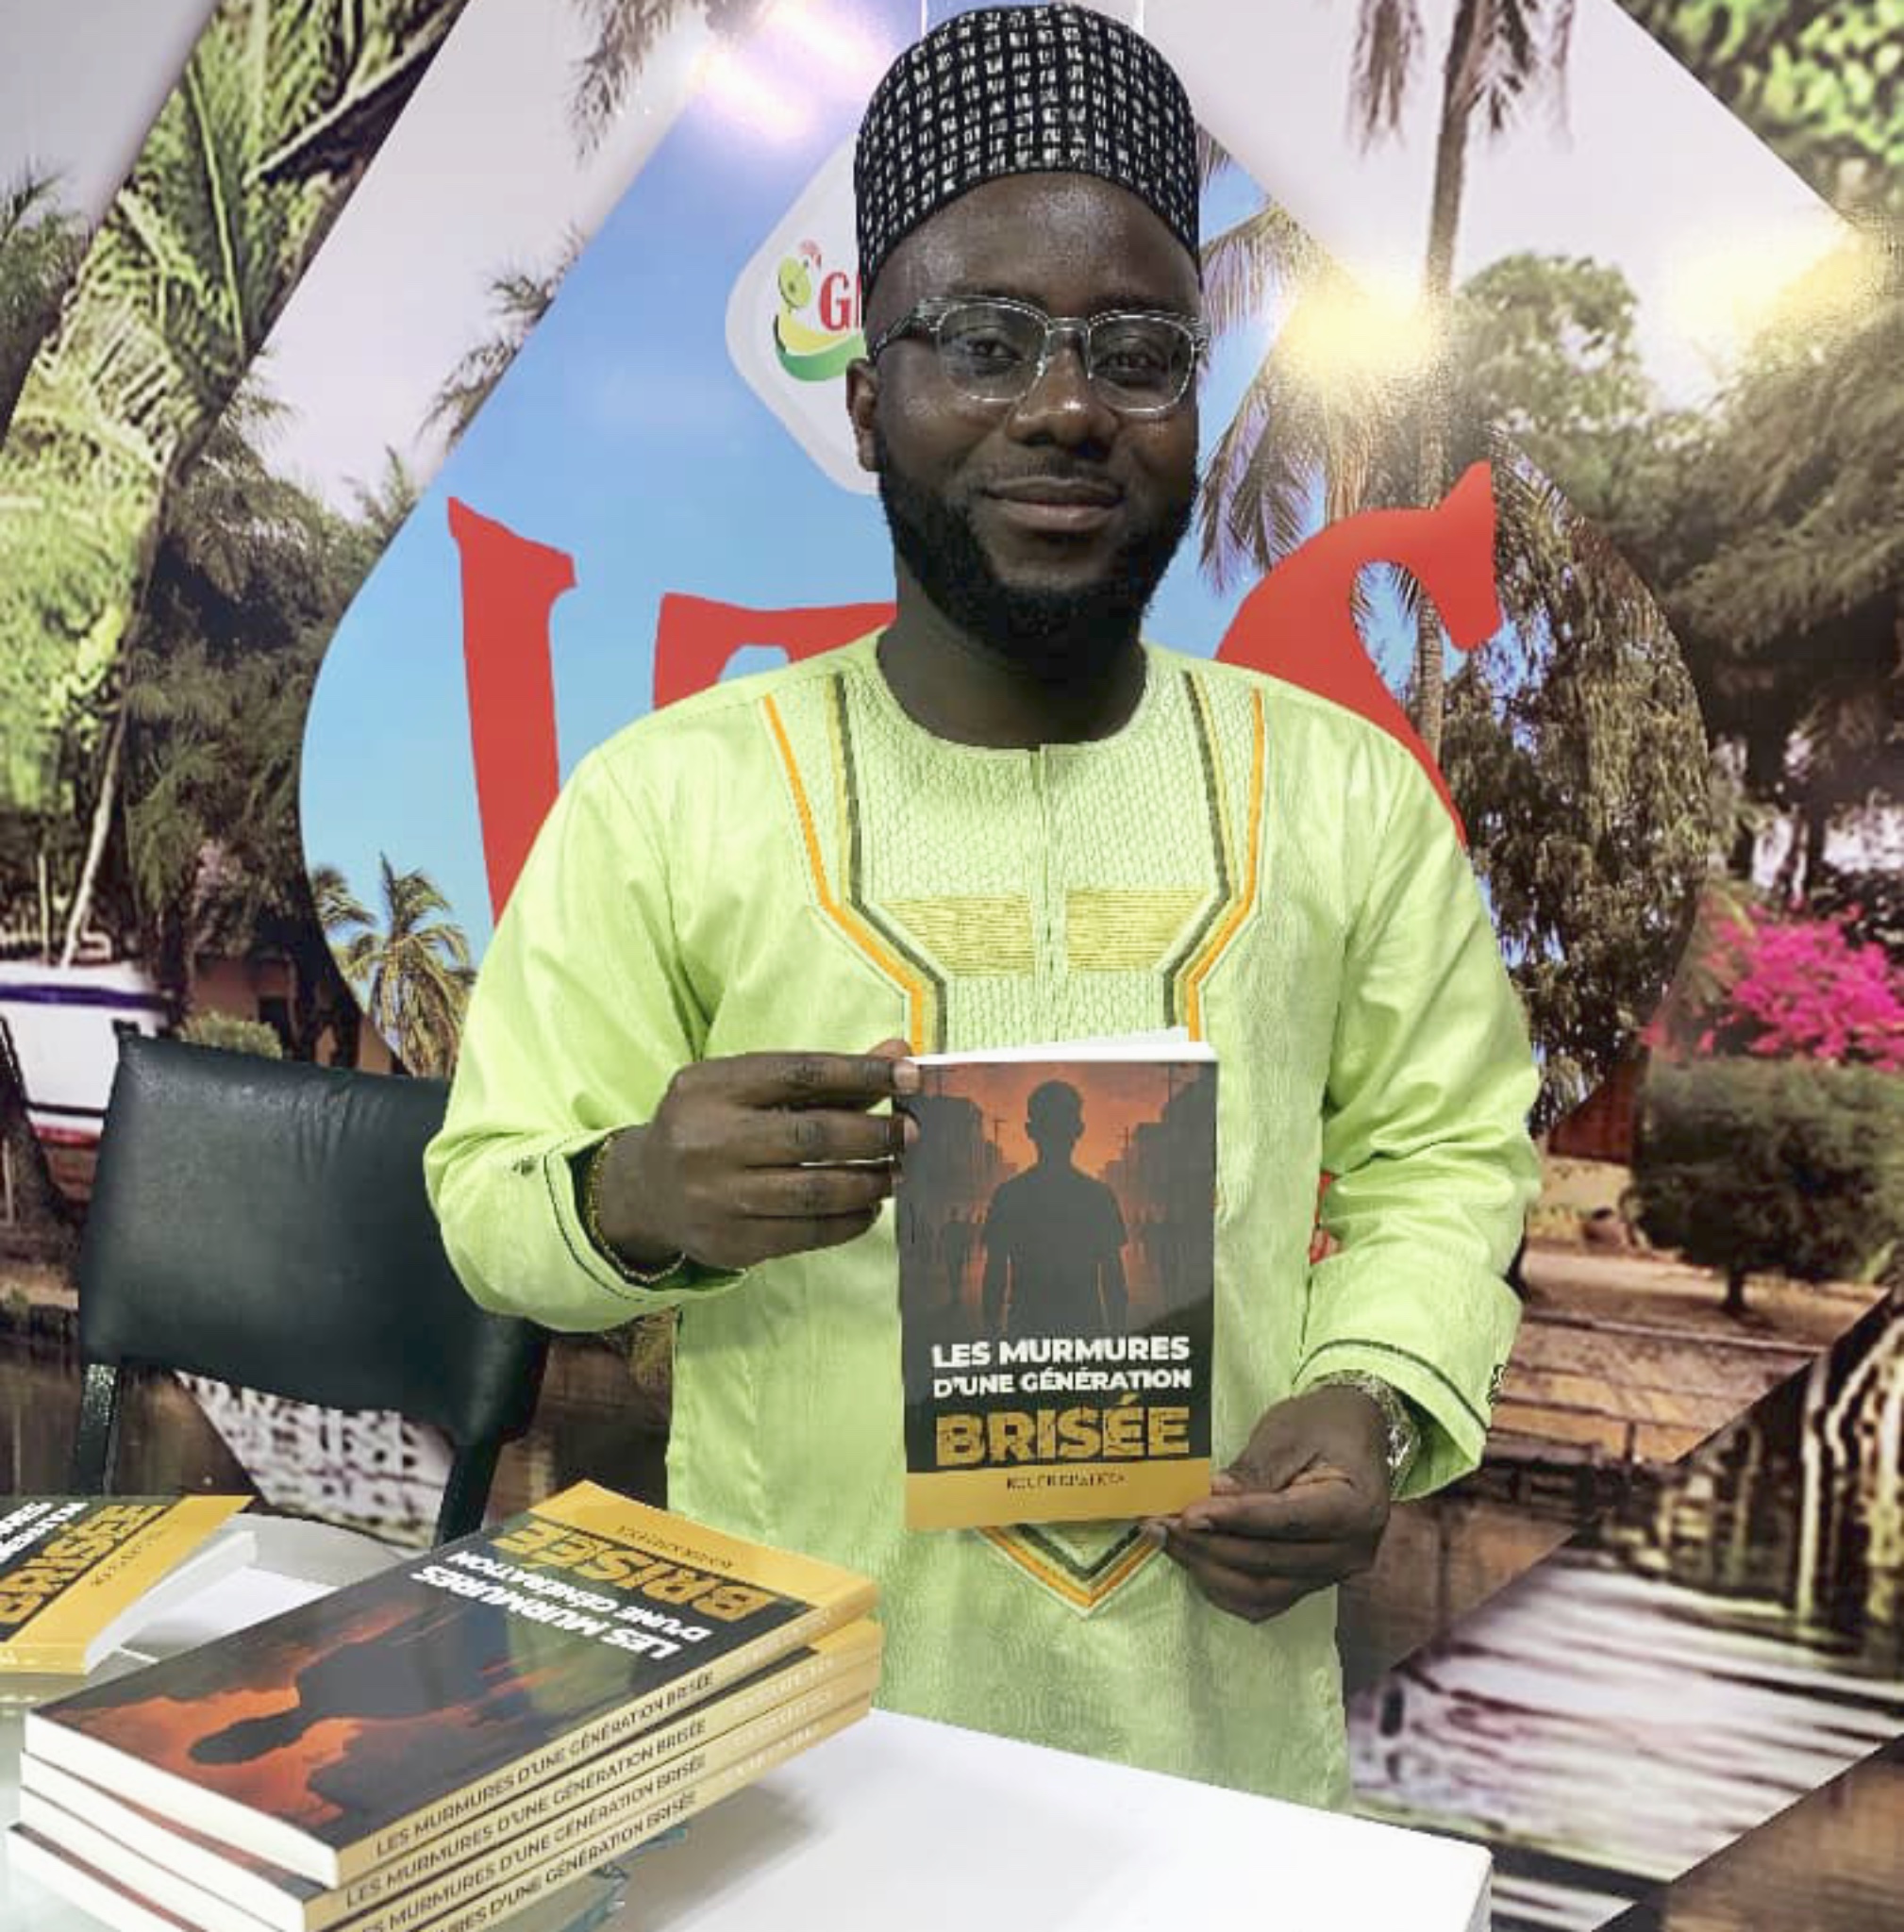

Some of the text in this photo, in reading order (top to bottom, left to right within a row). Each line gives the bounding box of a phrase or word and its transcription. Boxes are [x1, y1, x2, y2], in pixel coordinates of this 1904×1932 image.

[932, 1336, 1190, 1368] LES MURMURES
[932, 1368, 1192, 1398] D'UNE GÉNÉRATION
[936, 1393, 1190, 1466] BRISÉE
[409, 1565, 611, 1637] MURMURES
[490, 1520, 779, 1623] BRISÉE
[602, 1627, 681, 1659] LES
[376, 1828, 409, 1857] LES
[414, 1775, 515, 1836] MURMURES
[518, 1748, 564, 1784] D'UNE
[569, 1696, 663, 1757] GÉNÉRATION
[346, 1877, 381, 1908] LES
[388, 1825, 493, 1888] MURMURES
[498, 1794, 550, 1833] D'UNE
[390, 1862, 496, 1930] MURMURES
[500, 1833, 551, 1868] D'UNE
[554, 1778, 654, 1842] GÉNÉRATION
[657, 1753, 705, 1790] BRISÉE
[490, 1790, 696, 1913] D'UNE GÉNÉRATION BRISÉE
